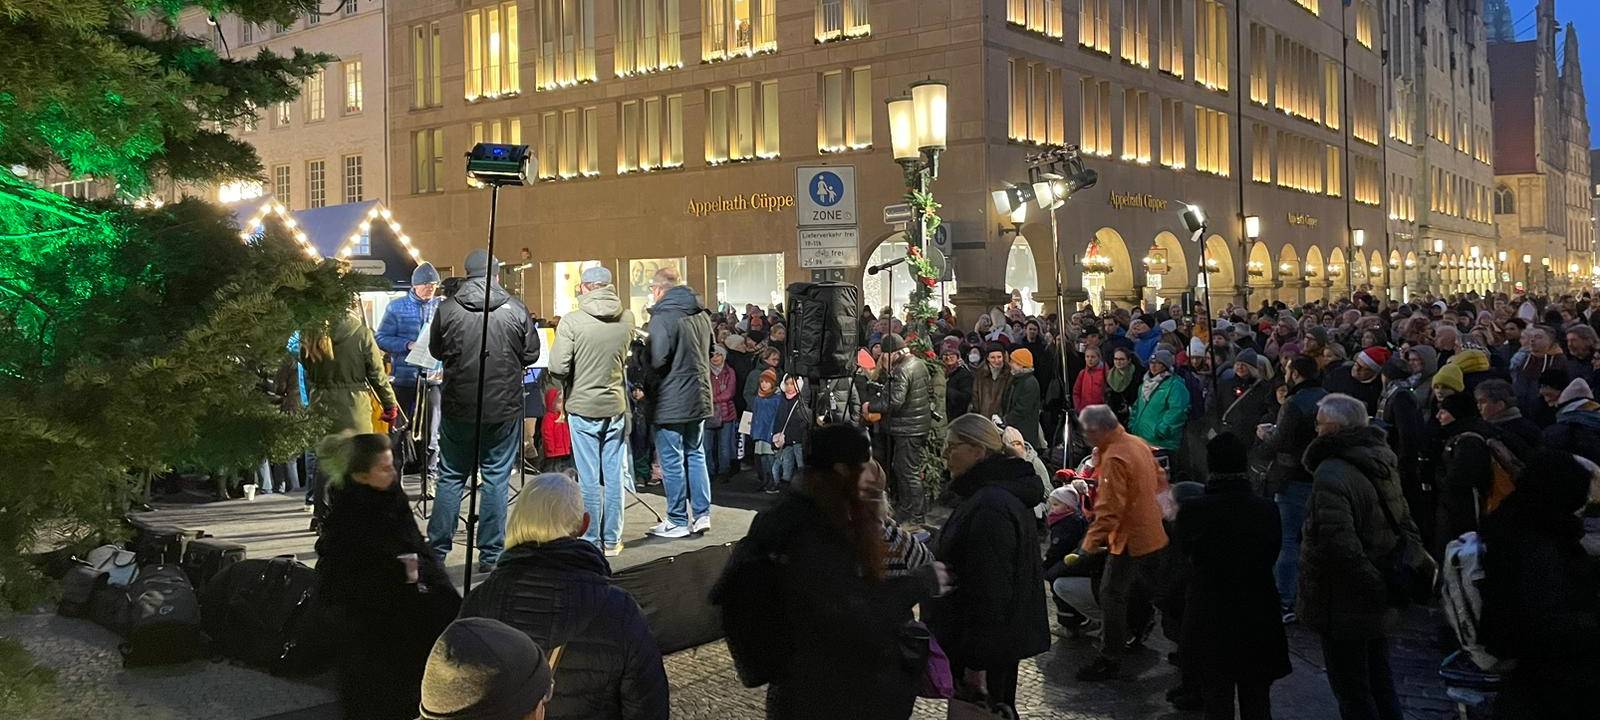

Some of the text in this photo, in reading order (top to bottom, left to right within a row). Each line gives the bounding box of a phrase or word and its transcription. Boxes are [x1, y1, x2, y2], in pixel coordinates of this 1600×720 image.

[687, 193, 796, 216] Appelrath Cüppe
[812, 210, 842, 221] ZONE
